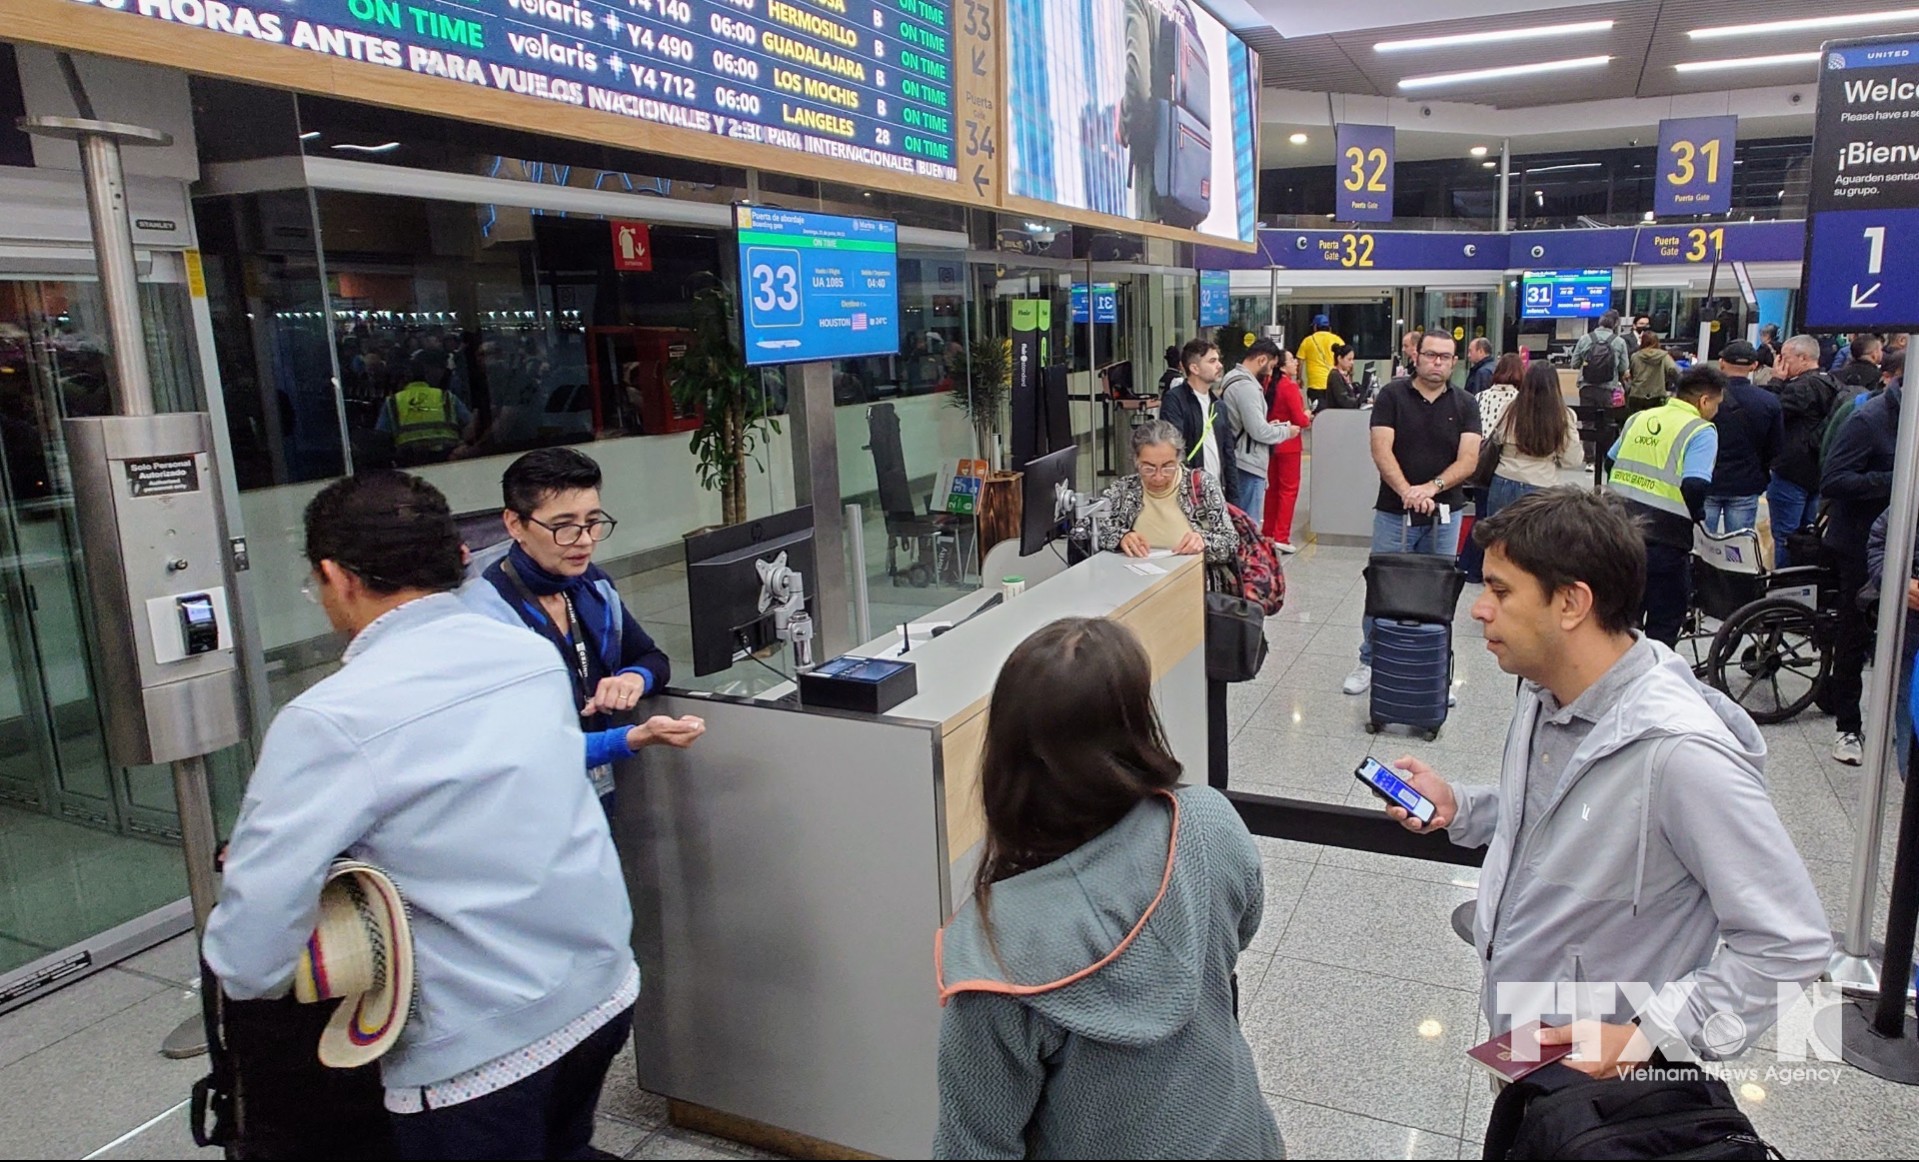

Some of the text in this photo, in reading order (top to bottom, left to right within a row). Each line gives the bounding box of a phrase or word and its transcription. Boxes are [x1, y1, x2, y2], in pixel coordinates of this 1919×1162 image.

[348, 0, 485, 49] ON TIME
[899, 0, 945, 26] ON TIME
[963, 0, 992, 42] 33
[767, 0, 858, 48] HERMOSILLO
[873, 10, 884, 28] B
[899, 22, 917, 41] ON
[918, 29, 946, 53] TIME
[627, 0, 652, 12] 4
[656, 0, 692, 24] 140
[710, 13, 756, 45] 06:00
[761, 31, 866, 81] GUADALAJARA
[874, 40, 885, 58] B
[900, 51, 919, 70] ON
[919, 57, 946, 80] TIME
[138, 0, 284, 43] HORAS
[291, 20, 403, 68] ANTES
[408, 45, 487, 86] PARA
[489, 63, 584, 105] VUELOS
[587, 85, 711, 132] NACIONALES
[712, 114, 726, 135] Y
[507, 22, 947, 109] volaris Y4 490 06:00 LOS MOCHIS B ON TIME
[1867, 49, 1910, 60] UNITED
[629, 63, 948, 138] Y4 712 06:00 L.ANGELES B ON TIME
[965, 90, 993, 110] Puerta
[1844, 77, 1919, 104] Welc
[1840, 112, 1874, 122] Please
[1875, 110, 1901, 120] have
[1901, 110, 1909, 118] a
[874, 128, 949, 160] 28 ON TIME
[965, 119, 995, 160] 34
[1343, 146, 1388, 192] 32
[1666, 139, 1720, 186] 31
[1833, 186, 1880, 198] su grupo.
[1834, 172, 1884, 186] Aguarden
[1351, 200, 1379, 209] Puerta Gate
[1674, 192, 1710, 203] Puerta Gate
[138, 220, 174, 230] STANLEY
[1318, 233, 1374, 267] Puerta 32
[1324, 250, 1339, 261] Gate
[1654, 227, 1725, 262] Puerta 31
[1660, 246, 1679, 256] Gate
[1863, 226, 1885, 274] 1
[752, 263, 799, 312] 33
[812, 276, 825, 288] UA
[1527, 286, 1550, 303] 31
[819, 317, 851, 328] HOUSTON
[130, 460, 192, 472] Solo Personal
[138, 469, 187, 480] Autorizado
